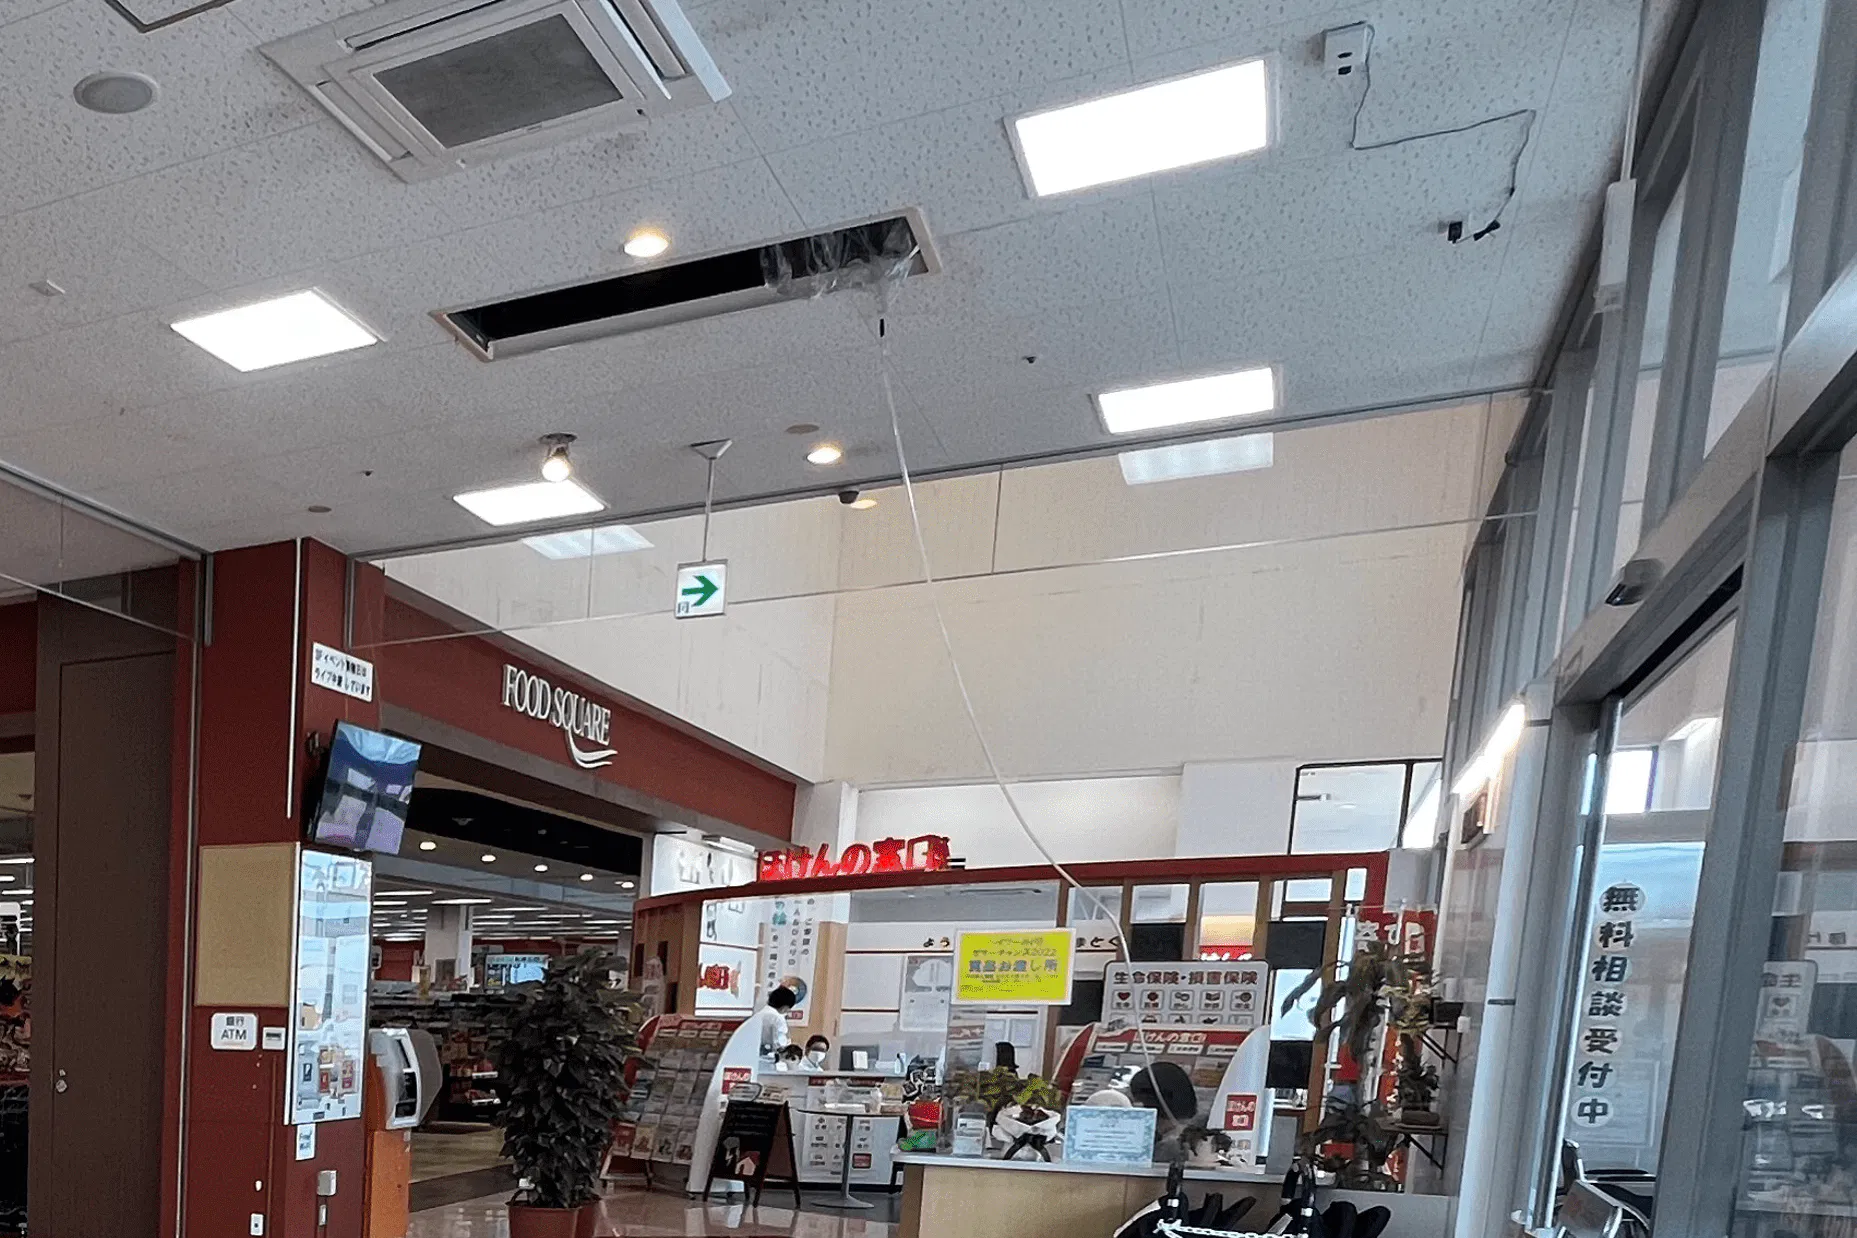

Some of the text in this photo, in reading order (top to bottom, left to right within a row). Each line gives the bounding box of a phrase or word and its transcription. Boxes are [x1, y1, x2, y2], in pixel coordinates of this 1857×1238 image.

[502, 664, 614, 755] FOOD SQUARE
[1113, 970, 1258, 985] 生命保険・損害保険
[1577, 886, 1640, 1124] 無料相談受付中
[220, 1029, 247, 1041] ATM
